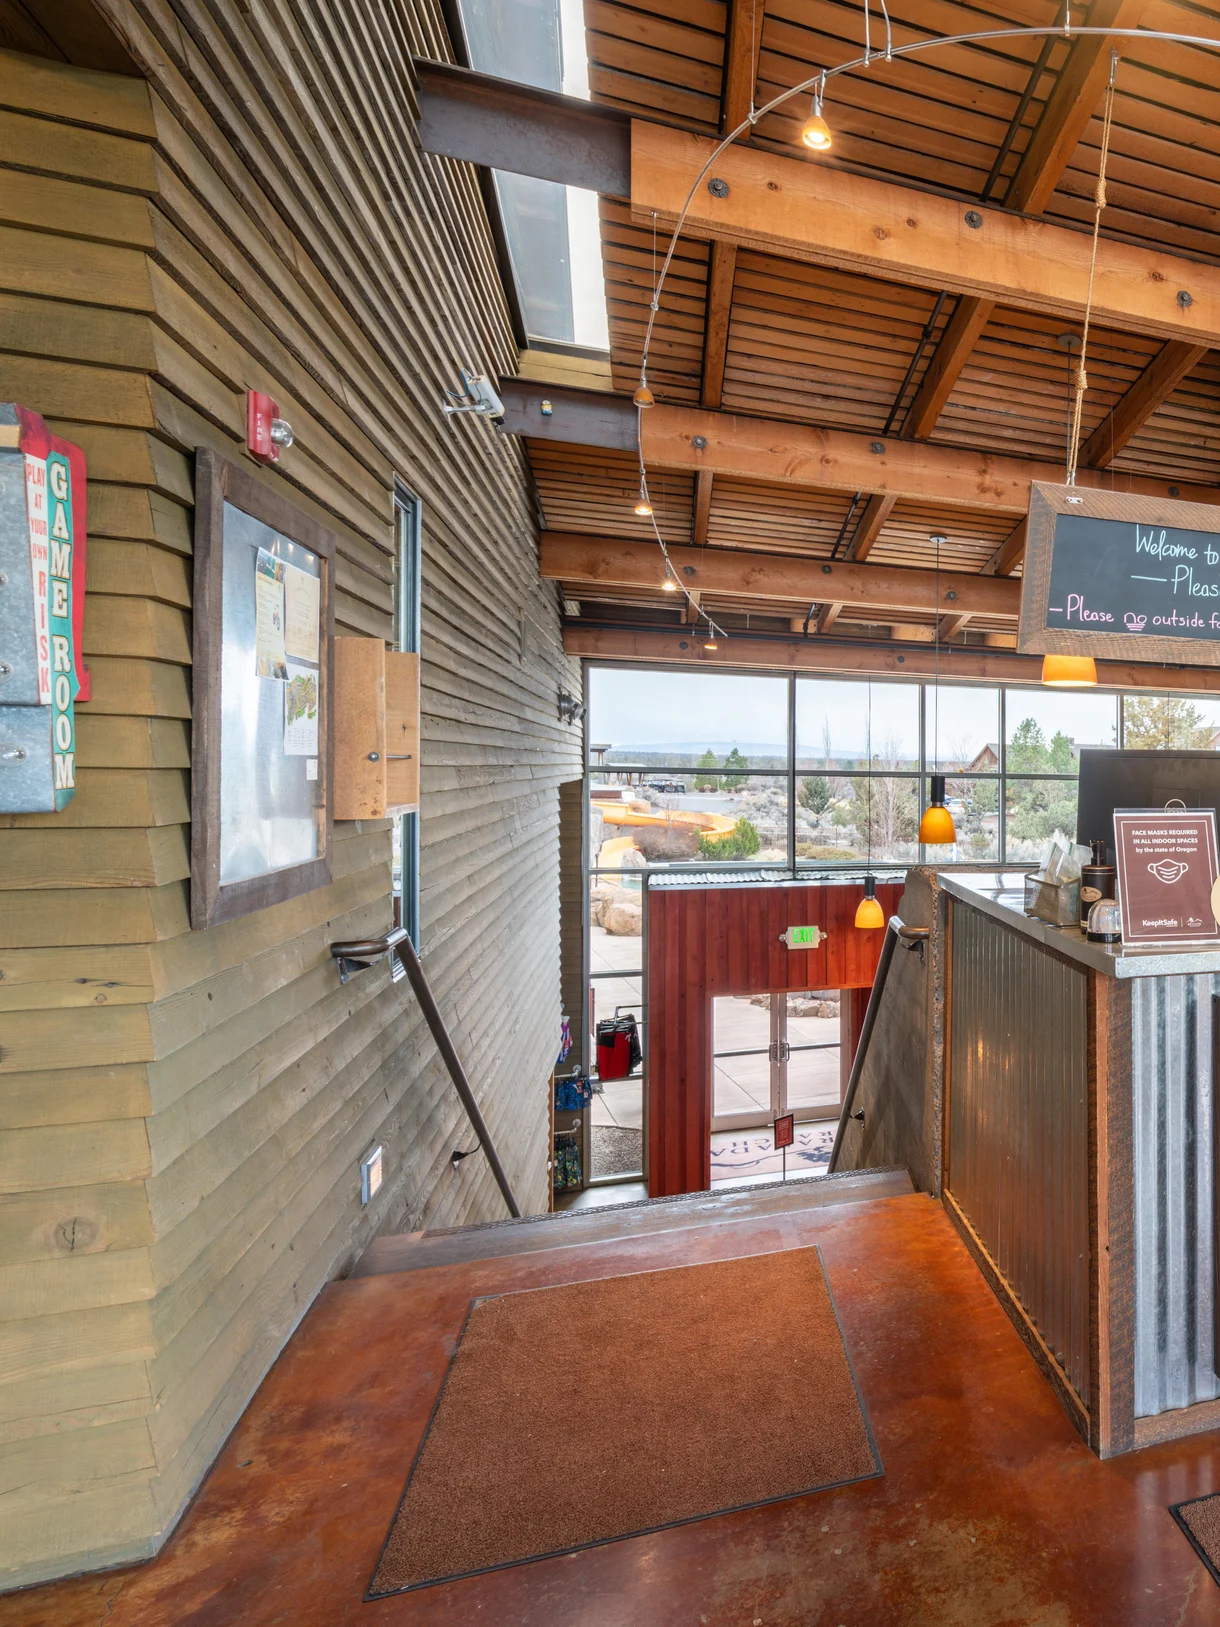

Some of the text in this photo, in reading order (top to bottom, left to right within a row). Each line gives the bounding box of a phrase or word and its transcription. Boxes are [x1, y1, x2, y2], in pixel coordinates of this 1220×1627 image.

[26, 463, 46, 488] PLAY
[34, 493, 42, 510] AT
[30, 517, 47, 536] YOUR
[32, 543, 48, 561] OWN
[1136, 524, 1198, 561] Welcome
[1204, 543, 1220, 565] to
[1067, 593, 1115, 622] Please
[1124, 612, 1147, 625] no
[1152, 609, 1206, 628] outside
[37, 570, 50, 693] RISK
[50, 461, 75, 790] GAME ROOM
[1142, 919, 1178, 927] KeepItSafe
[793, 927, 815, 943] EXIT
